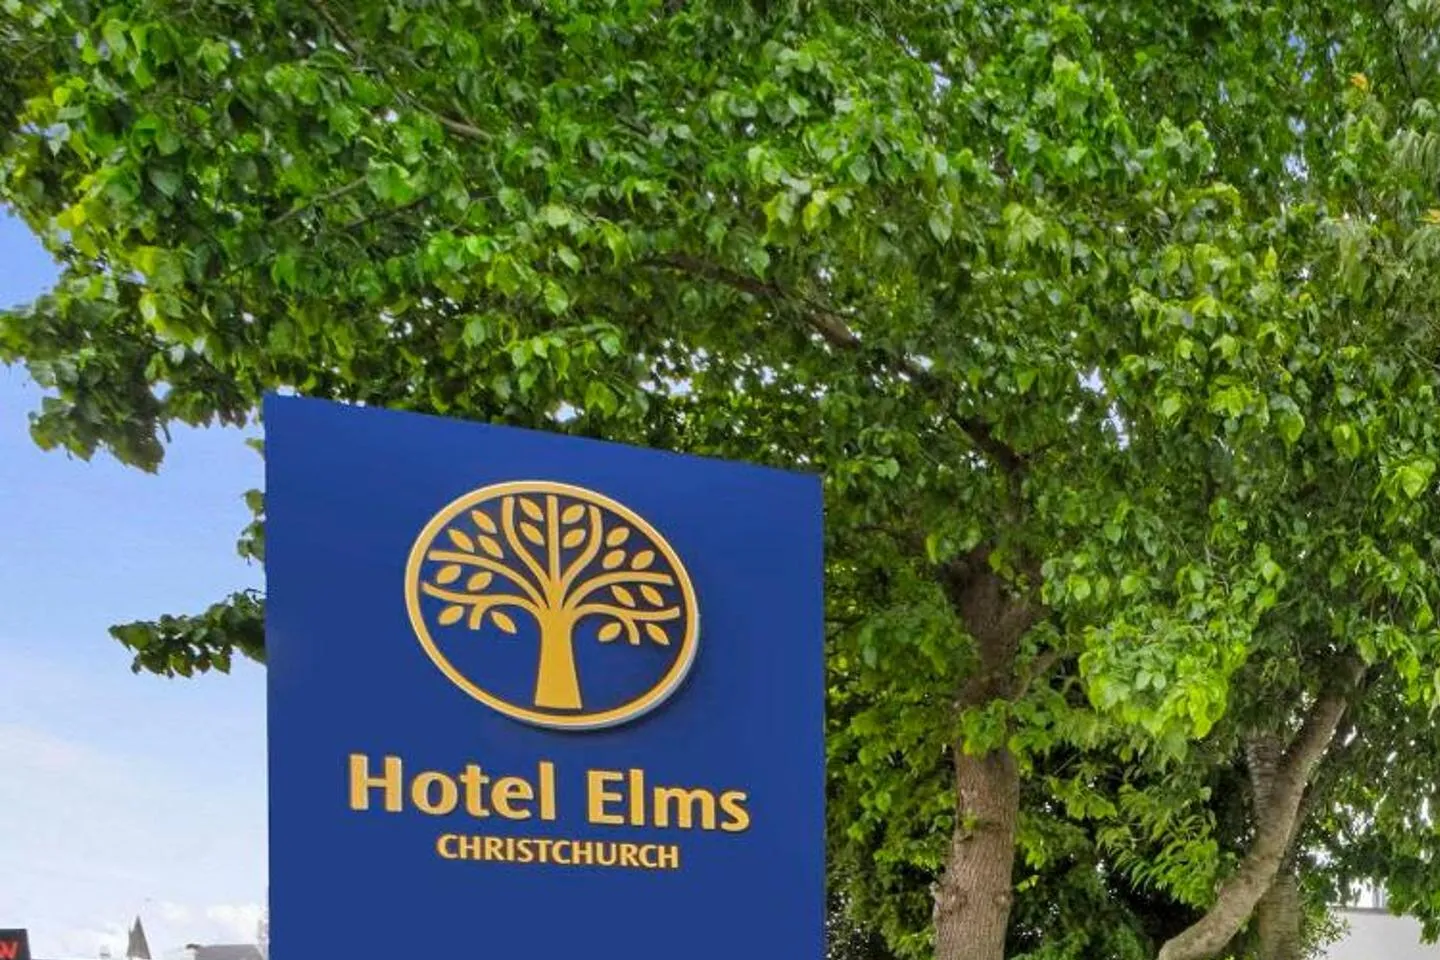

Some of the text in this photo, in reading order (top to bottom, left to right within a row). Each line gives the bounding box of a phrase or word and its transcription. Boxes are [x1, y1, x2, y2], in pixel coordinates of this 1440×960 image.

[349, 752, 751, 832] Hotel Elms
[436, 833, 680, 869] CHRISTCHURCH
